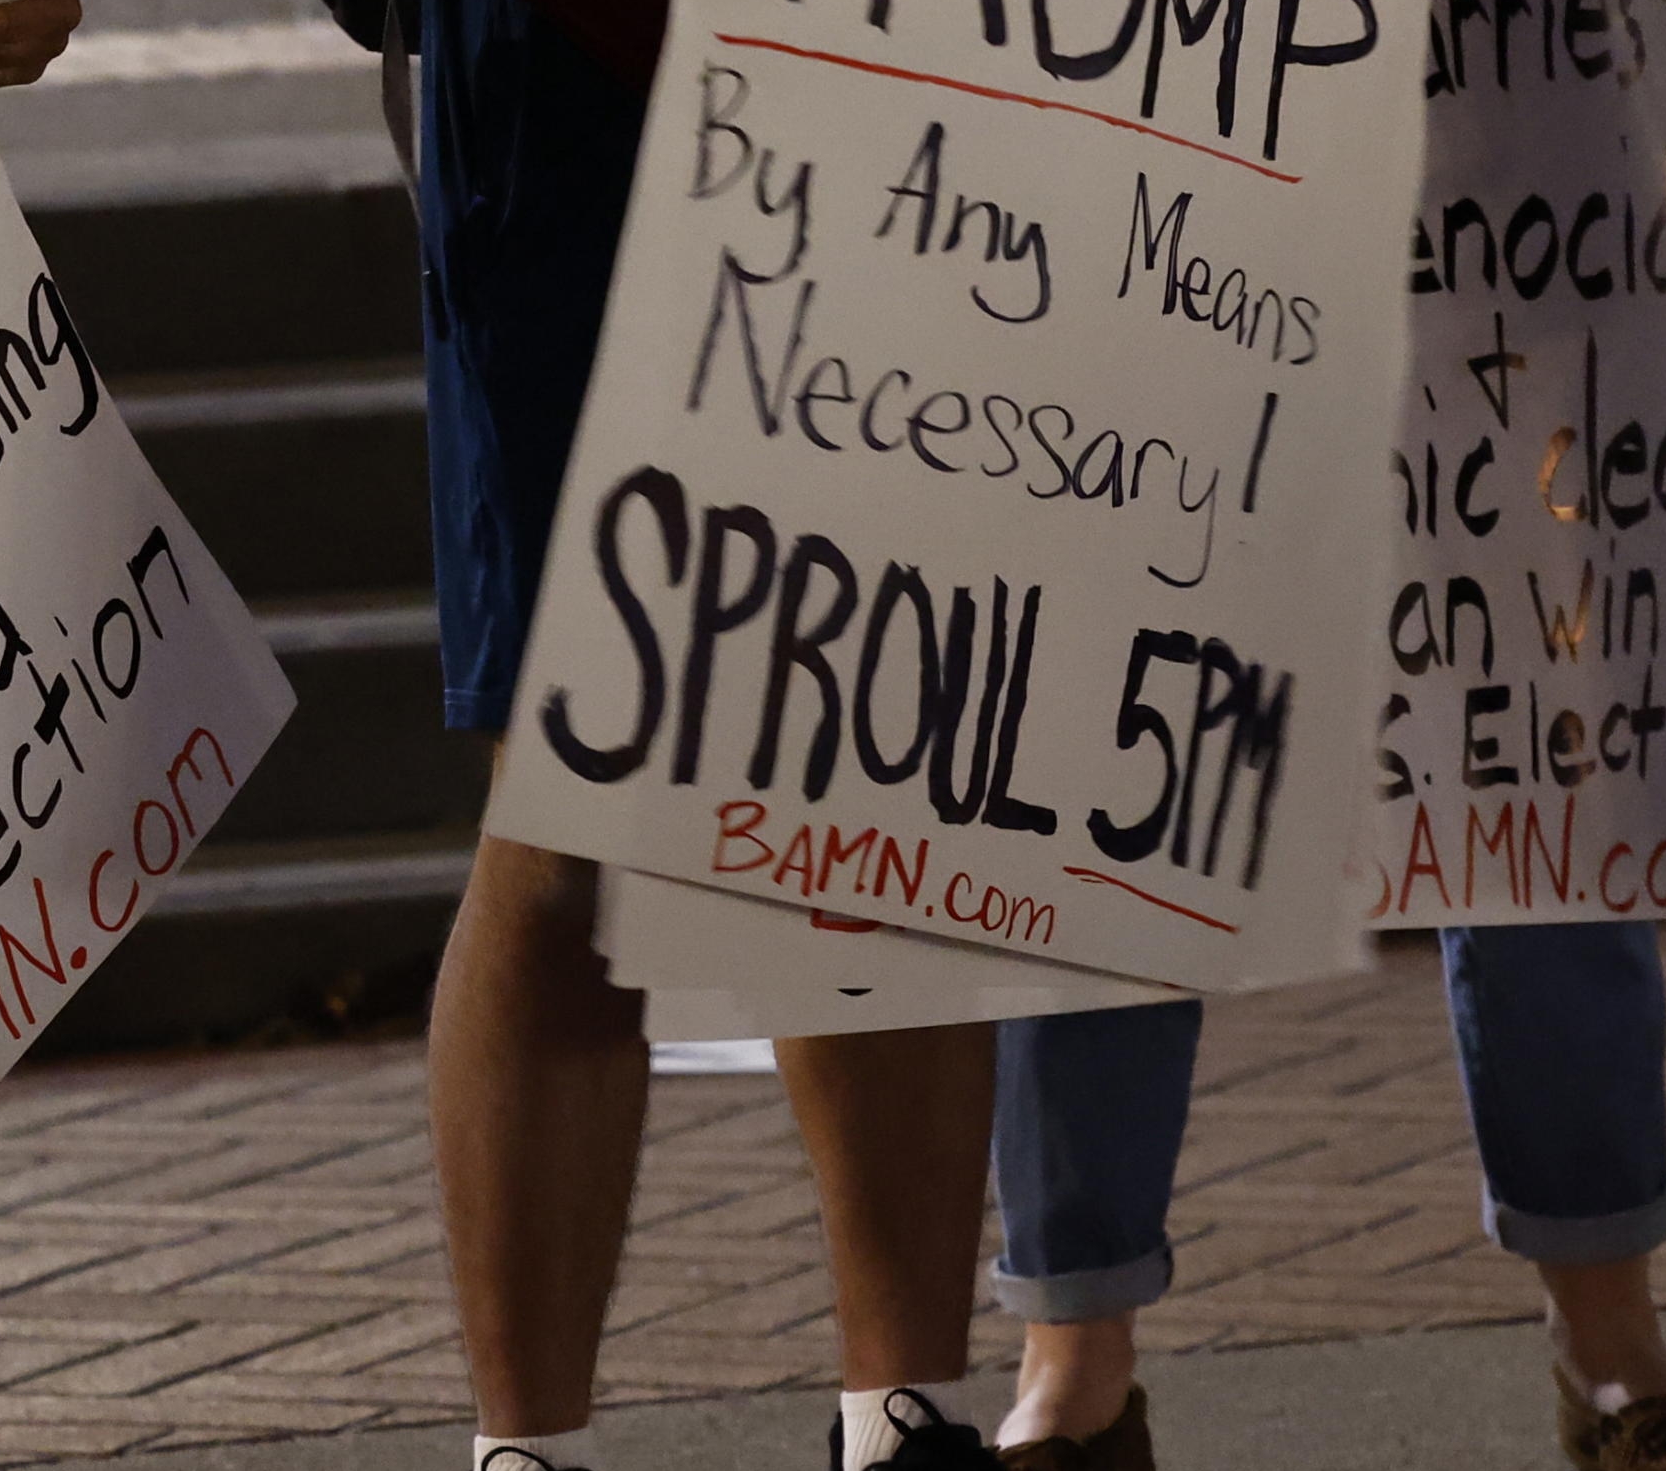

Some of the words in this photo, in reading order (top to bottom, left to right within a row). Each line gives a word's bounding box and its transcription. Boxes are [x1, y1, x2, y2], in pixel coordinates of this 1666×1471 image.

[690, 64, 815, 284] By
[874, 121, 1051, 323] Any
[1118, 172, 1321, 364] Means
[687, 247, 1278, 589] Necessary!
[542, 465, 1058, 836] SPROUL
[1087, 627, 1295, 892] 5PM
[1388, 574, 1495, 679] an
[1527, 536, 1659, 665] win
[1373, 691, 1434, 804] S.
[711, 800, 1059, 946] BAMN.com
